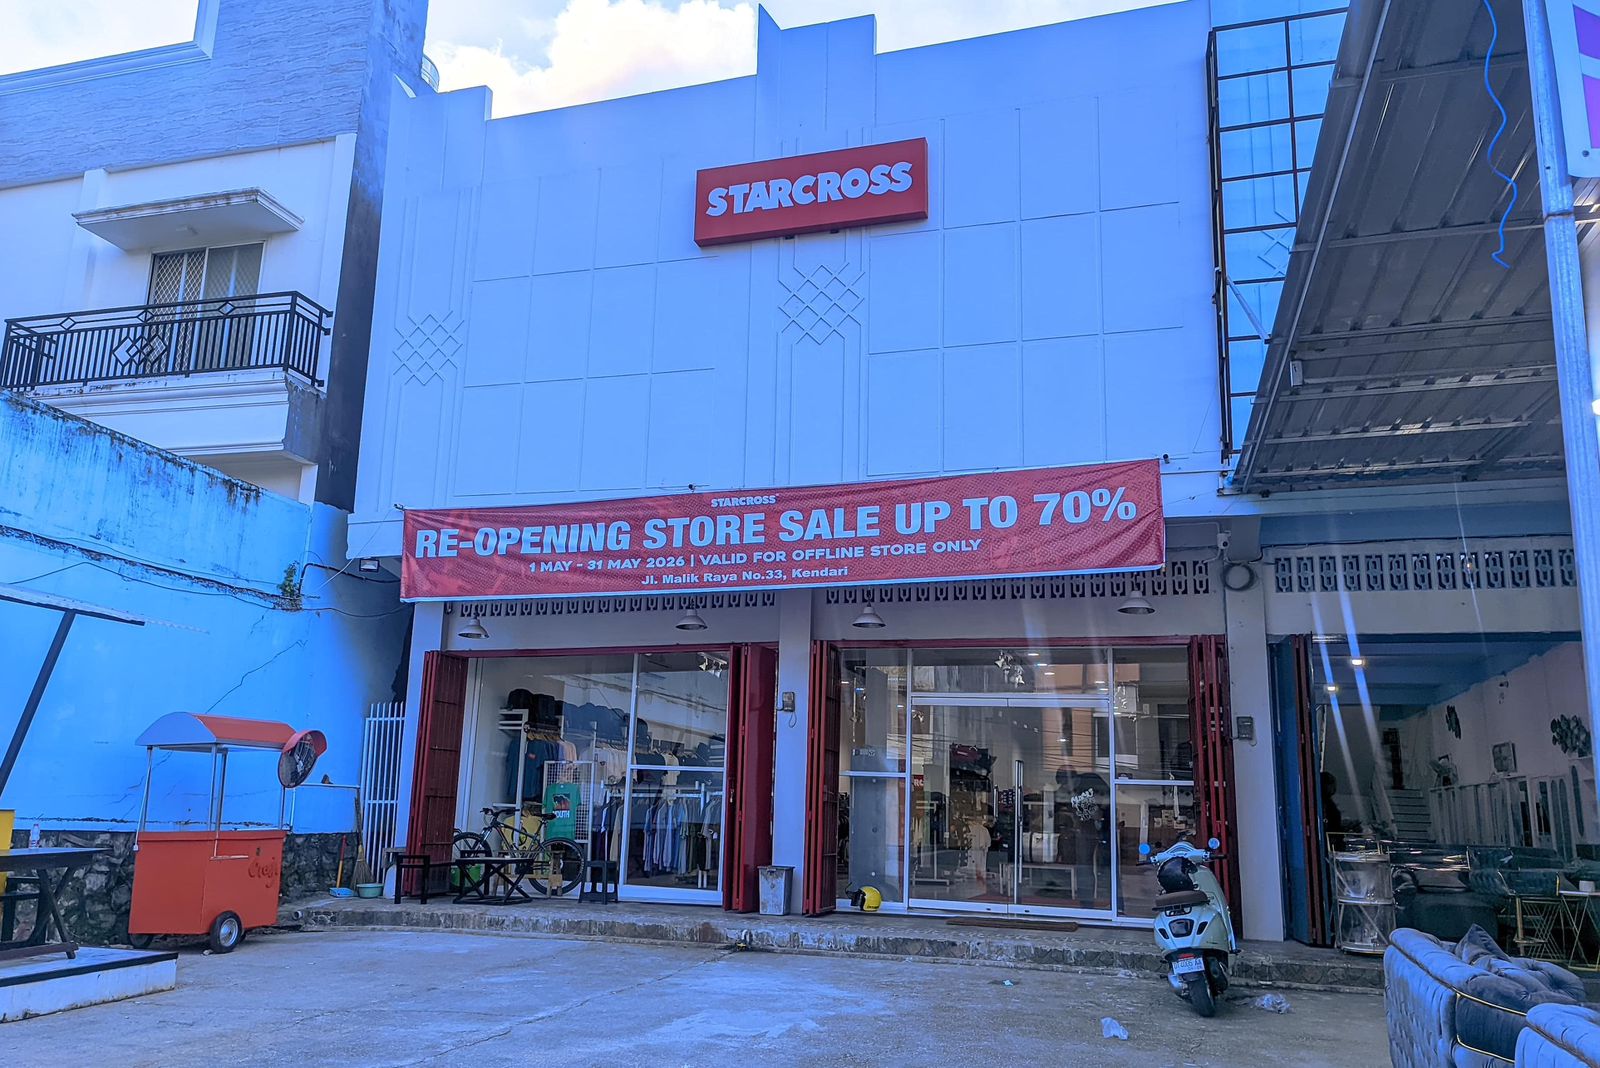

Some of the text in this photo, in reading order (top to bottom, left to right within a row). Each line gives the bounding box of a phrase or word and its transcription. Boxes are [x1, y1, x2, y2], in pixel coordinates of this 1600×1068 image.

[706, 162, 913, 217] STARCROSS
[711, 495, 776, 508] STARCROSS
[414, 487, 1137, 558] RE-OPENING STORE SALE UP TO 70%
[529, 562, 536, 573] 1
[539, 560, 574, 573] MAY
[587, 559, 603, 571] 31
[607, 558, 642, 570] MAY
[645, 555, 686, 568] 2026
[699, 552, 748, 566] VALID
[752, 550, 787, 563] FOR
[791, 546, 865, 561] OFFLINE
[870, 542, 927, 557] STORE
[932, 538, 983, 553] ONLY
[641, 566, 848, 585] Jl. Malik Raya No.33, Kendari
